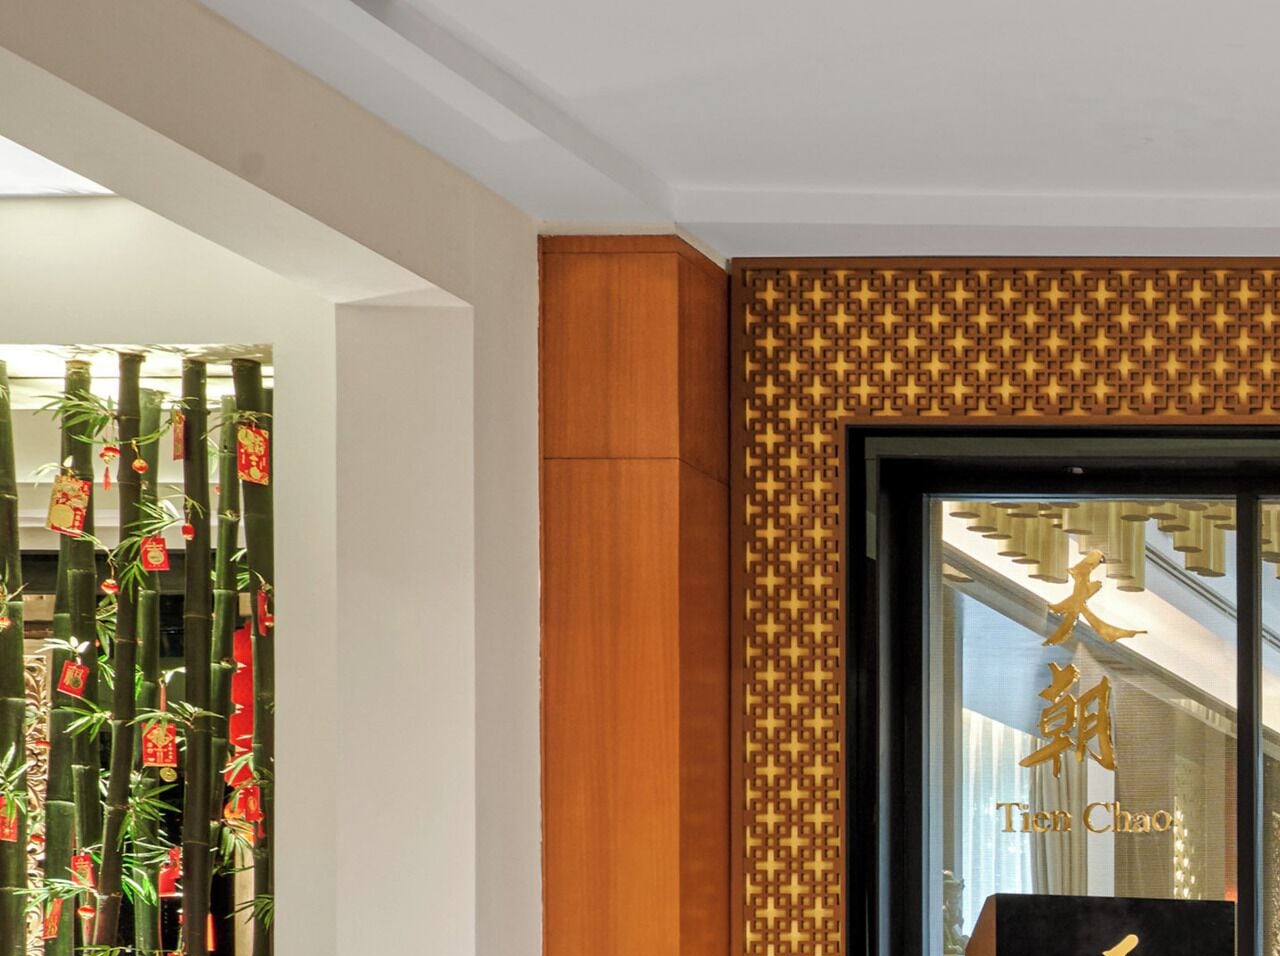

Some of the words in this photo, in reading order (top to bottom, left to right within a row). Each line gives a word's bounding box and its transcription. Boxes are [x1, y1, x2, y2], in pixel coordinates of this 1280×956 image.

[1019, 550, 1148, 778] 天朝
[996, 802, 1072, 833] Tien
[1083, 801, 1174, 833] Chao
